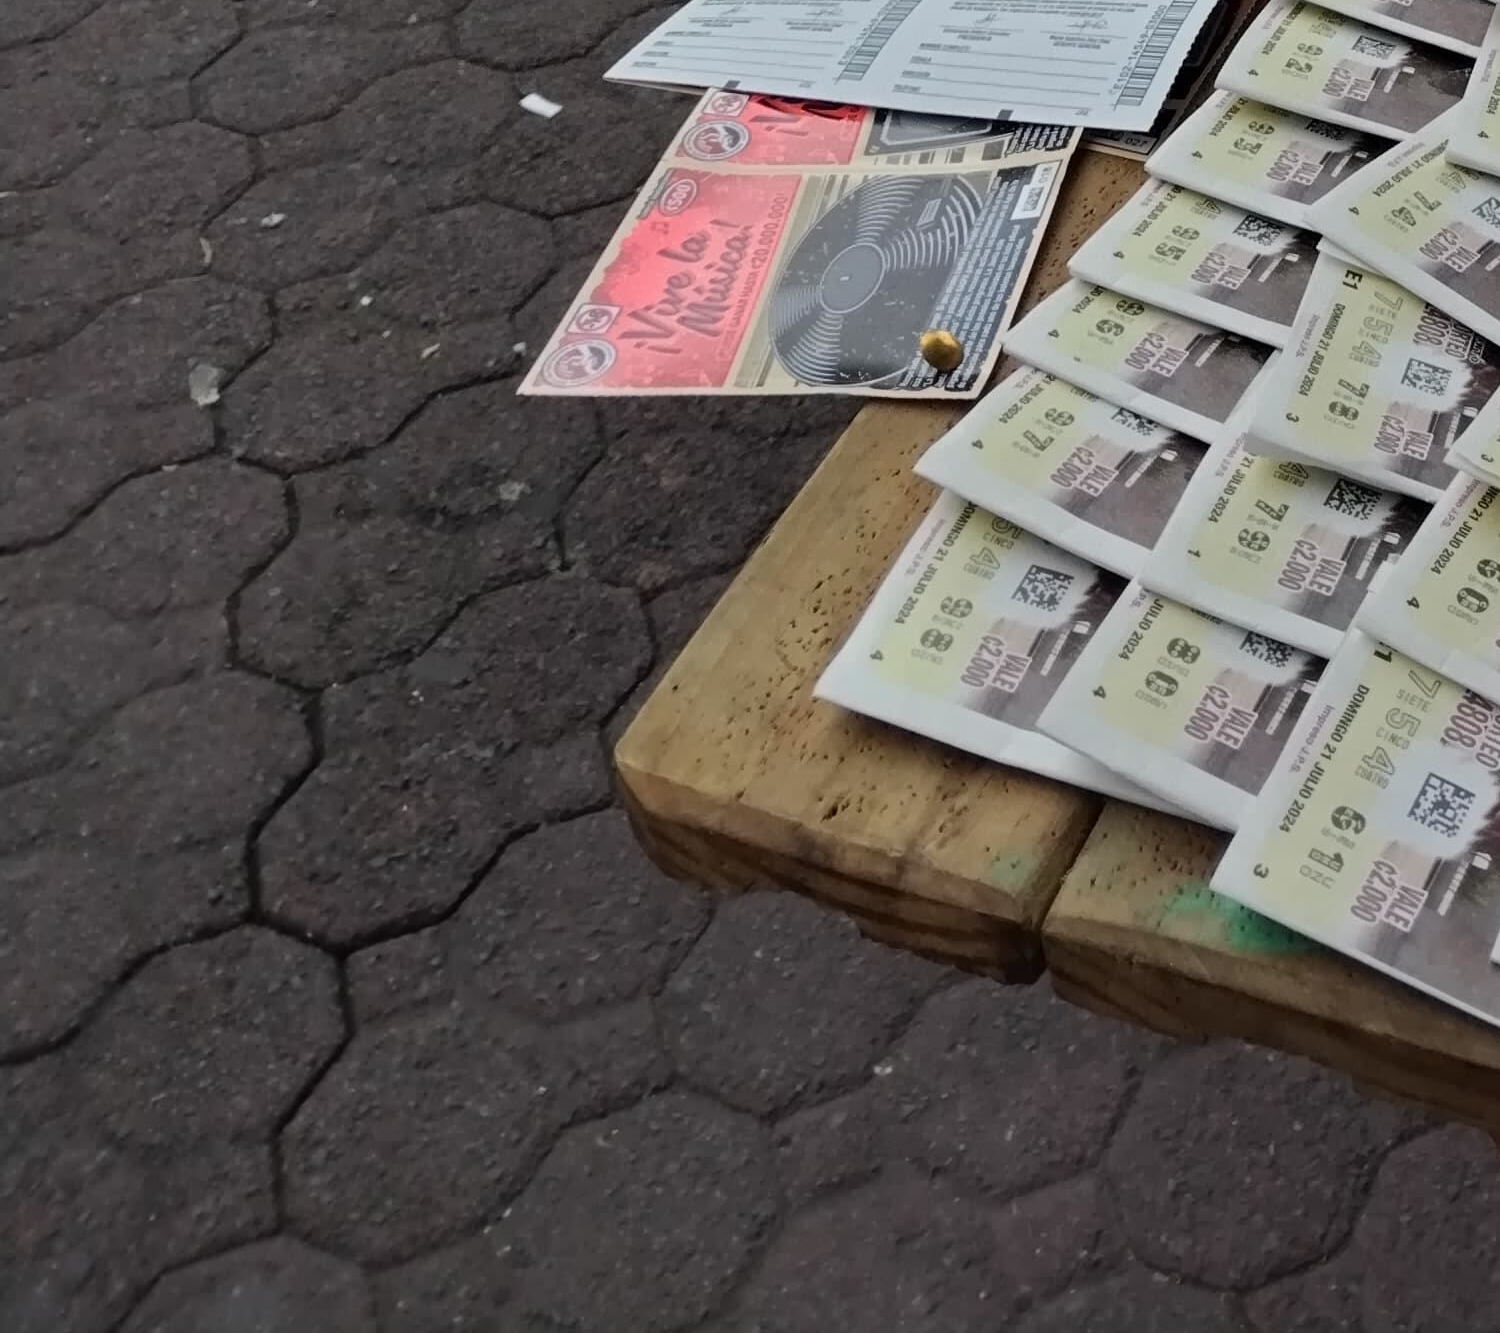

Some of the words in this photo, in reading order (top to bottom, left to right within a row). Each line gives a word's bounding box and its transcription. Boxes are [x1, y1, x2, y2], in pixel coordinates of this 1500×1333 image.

[657, 230, 713, 264] la
[1442, 239, 1482, 273] VALE
[1342, 269, 1363, 290] E1
[1150, 347, 1189, 378] VALE
[1401, 431, 1433, 461] VALE
[1078, 464, 1120, 497] VALE
[1447, 521, 1474, 551] JULIO
[914, 561, 938, 595] JULIO
[1307, 553, 1347, 596] VALE
[1430, 548, 1454, 576] 2024
[894, 595, 919, 625] 2024
[1139, 596, 1165, 633] JULIO
[1405, 595, 1420, 611] 4
[1117, 632, 1141, 662] 2024
[990, 648, 1032, 693] VALE
[1214, 706, 1258, 750] VALE
[1331, 683, 1371, 744] DOMINGO
[1322, 742, 1338, 762] 21
[1300, 760, 1329, 799] JULIO
[1278, 797, 1308, 834] 2024
[1252, 862, 1270, 880] 3
[1385, 883, 1427, 933] VALE
